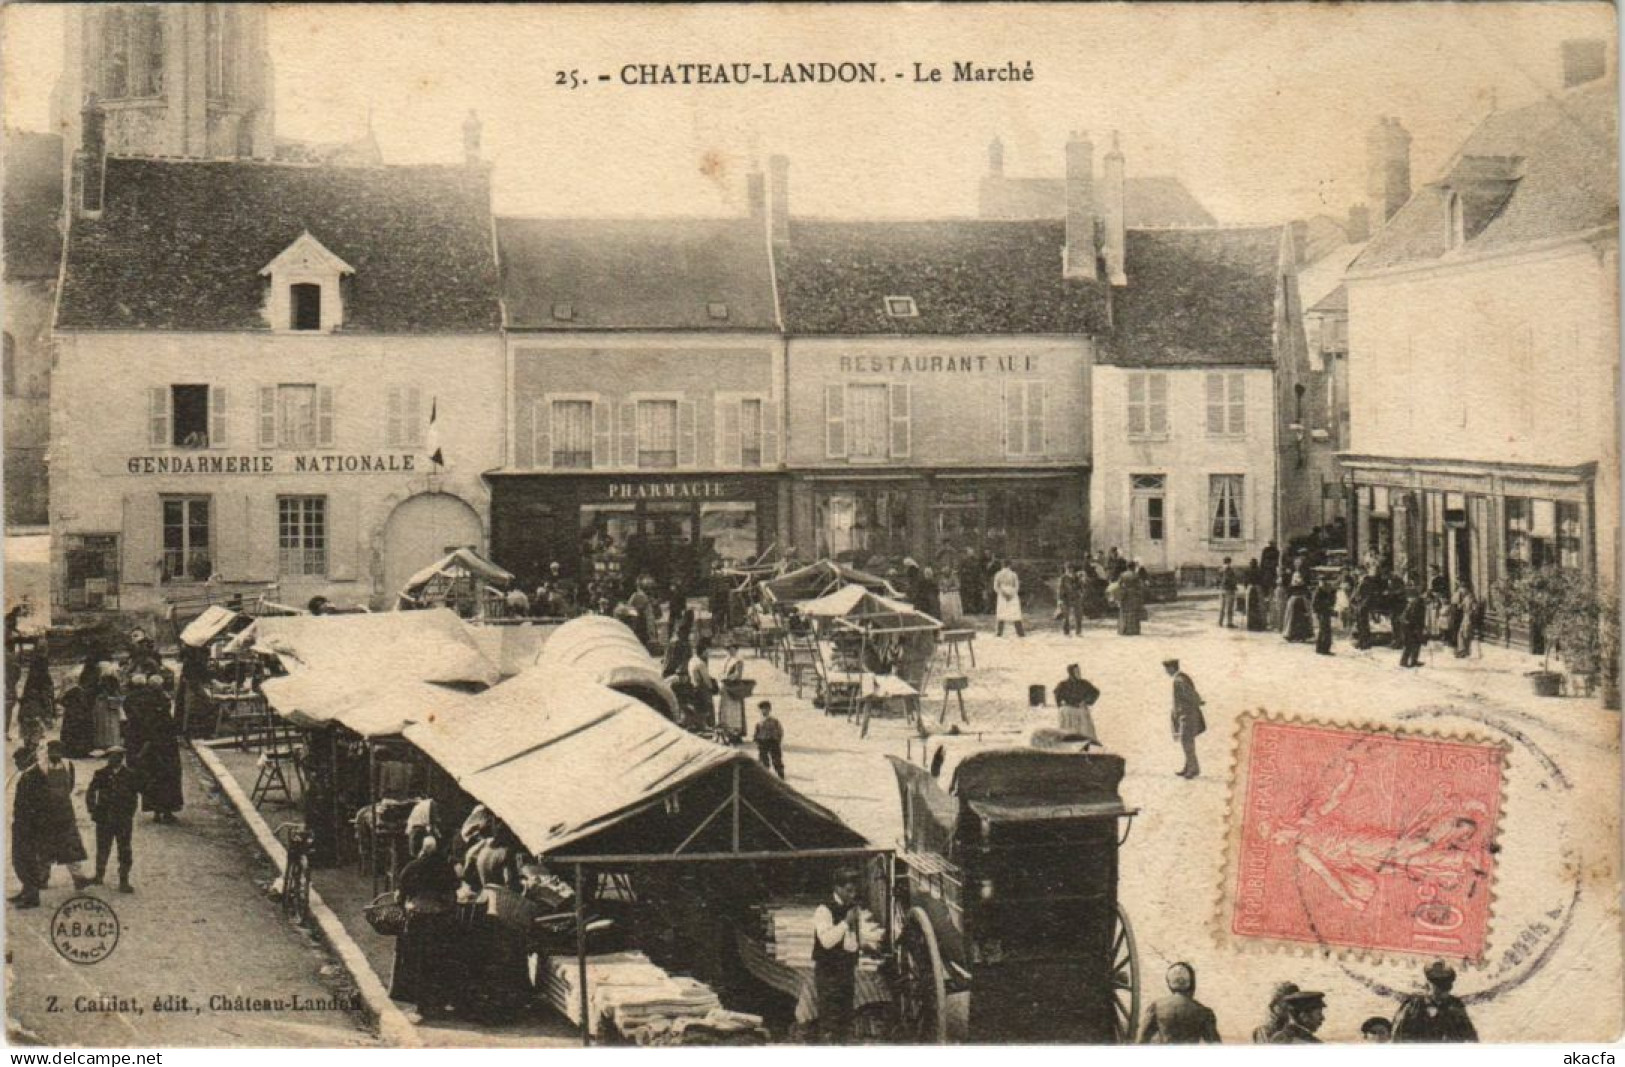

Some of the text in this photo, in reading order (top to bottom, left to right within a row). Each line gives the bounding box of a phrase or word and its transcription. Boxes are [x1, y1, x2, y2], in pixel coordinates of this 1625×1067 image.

[839, 355, 988, 372] RESTAURANT
[127, 455, 415, 474] GENDARMERIE NATIONALE
[608, 481, 726, 498] PHARMACIE
